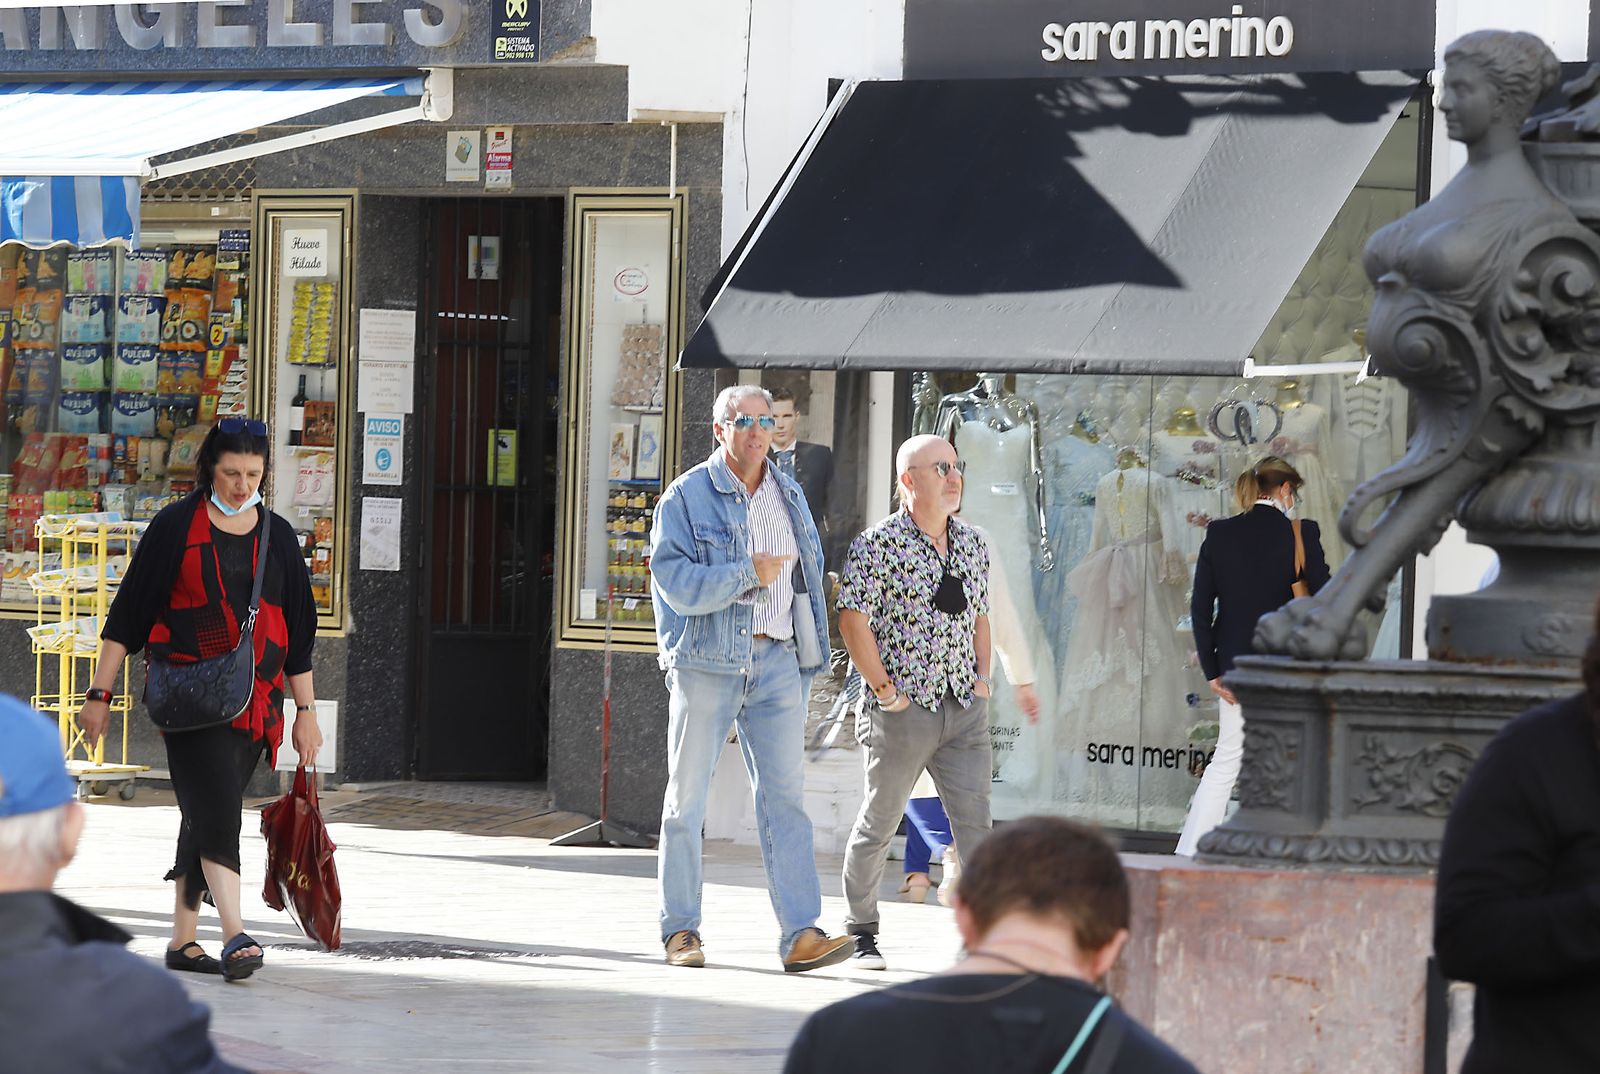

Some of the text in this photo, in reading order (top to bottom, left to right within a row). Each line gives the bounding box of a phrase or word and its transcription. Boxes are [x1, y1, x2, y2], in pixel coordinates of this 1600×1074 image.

[1041, 4, 1294, 62] sara merino
[487, 153, 511, 163] Alarma
[291, 236, 320, 249] Huevo
[289, 256, 321, 269] Hilado
[213, 329, 221, 342] 2
[122, 349, 151, 358] PULEVA
[119, 399, 149, 409] PULEVA
[368, 421, 400, 433] AVISO
[1087, 742, 1134, 766] sara
